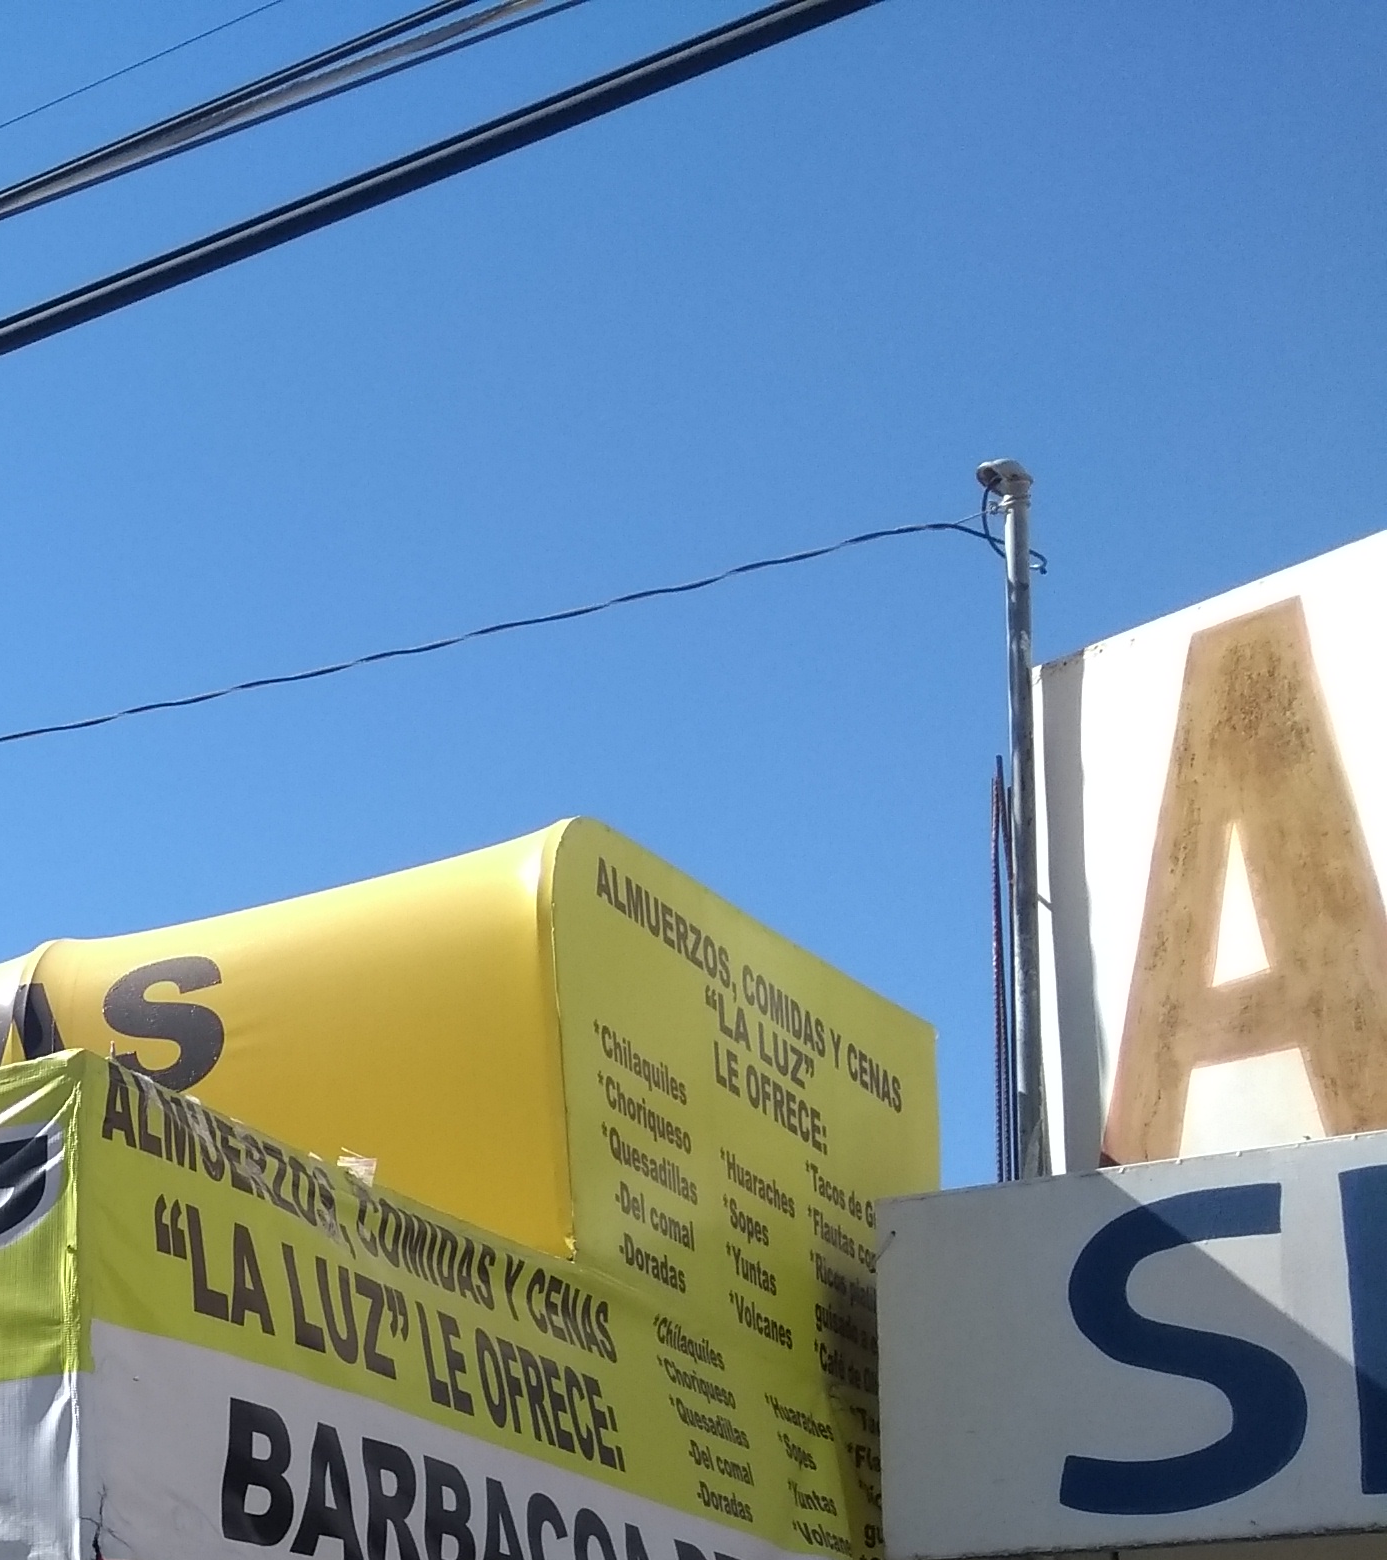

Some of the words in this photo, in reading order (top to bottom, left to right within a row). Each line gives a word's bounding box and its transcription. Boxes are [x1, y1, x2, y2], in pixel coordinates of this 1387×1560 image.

[595, 856, 737, 1002] ALMUERZOS,
[741, 964, 826, 1058] COMIDAS
[830, 1026, 842, 1069] Y
[846, 1042, 903, 1114] CENAS
[714, 1040, 740, 1098] LE
[745, 1063, 829, 1155] OFRECE:
[649, 1206, 695, 1251] comal
[847, 1190, 863, 1221] de
[356, 1181, 496, 1312] COMIDAS
[503, 1254, 524, 1322] Y
[526, 1268, 619, 1364] CENAS
[415, 1301, 475, 1417] LE
[475, 1325, 627, 1473] OFRECE:
[716, 1449, 755, 1487] comal
